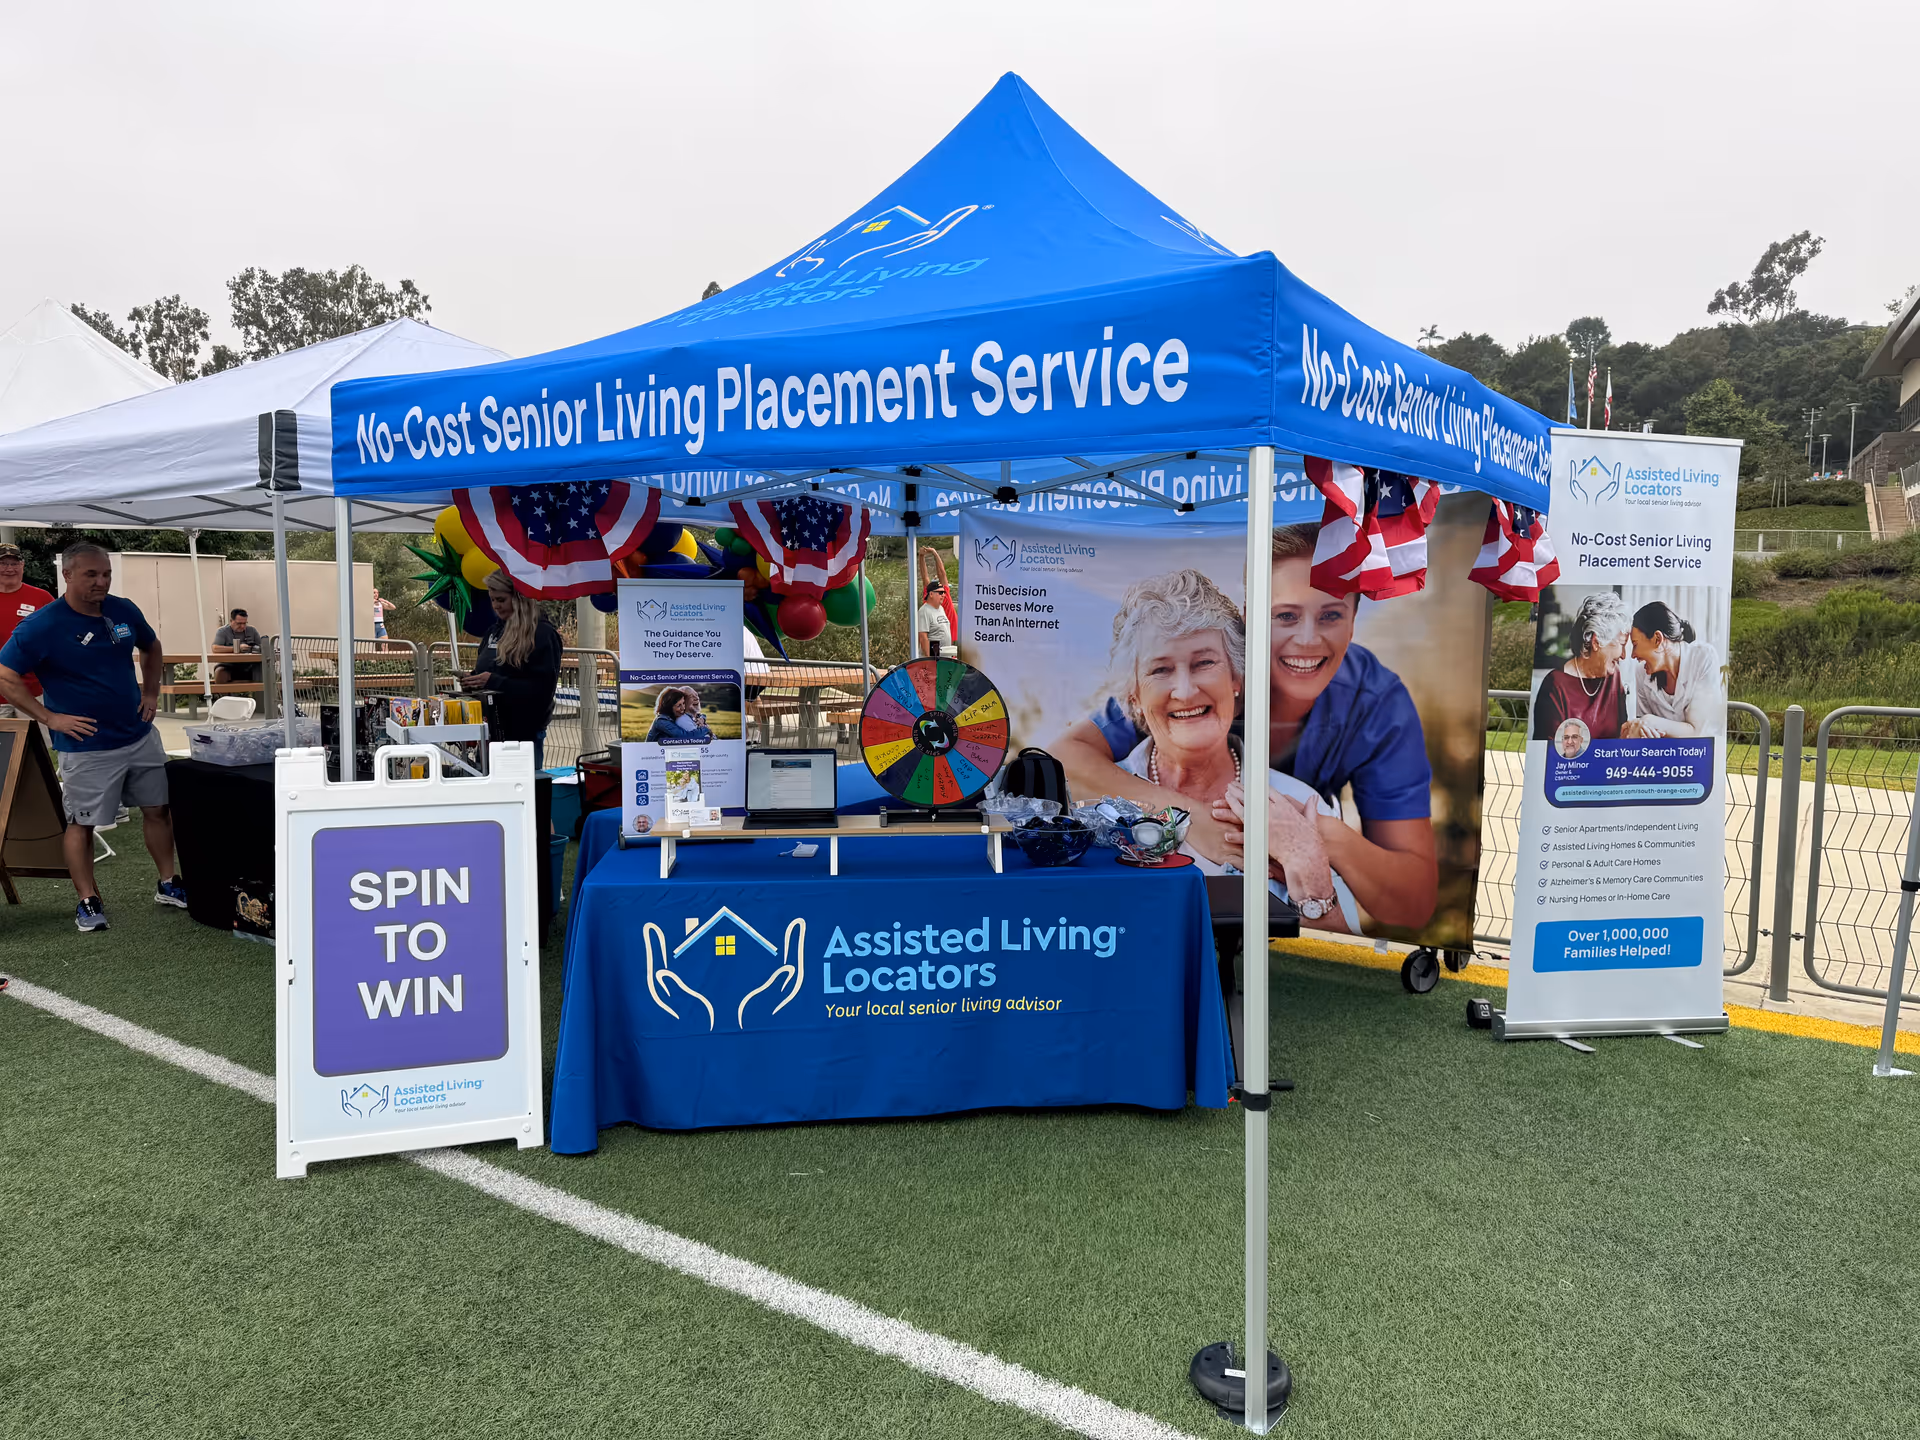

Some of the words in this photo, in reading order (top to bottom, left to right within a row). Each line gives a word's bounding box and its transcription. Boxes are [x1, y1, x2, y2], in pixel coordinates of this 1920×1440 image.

[829, 257, 989, 287] Living
[356, 401, 475, 464] No-Cost
[480, 388, 587, 453] Senior
[595, 373, 705, 455] Living
[717, 348, 957, 432] Placement
[971, 326, 1189, 417] Service
[1301, 323, 1391, 427] No-Cost
[1388, 363, 1440, 441] Senior
[1441, 384, 1481, 474] Living
[1482, 403, 1538, 481] Placement
[1625, 466, 1681, 482] Assisted
[1683, 468, 1719, 487] Living
[1624, 481, 1682, 497] Locators
[1571, 532, 1626, 546] No-Cost
[1629, 533, 1673, 547] Senior
[1676, 534, 1712, 552] Living
[1021, 543, 1062, 555] Assisted
[1064, 544, 1095, 557] Living
[1020, 553, 1065, 565] Locators
[1579, 554, 1650, 568] Placement
[1654, 555, 1702, 568] Service
[975, 584, 996, 595] This
[998, 585, 1047, 597] Decision
[975, 600, 1021, 612] Deserves
[1024, 602, 1054, 613] More
[974, 615, 1000, 627] Than
[1002, 616, 1014, 627] An
[1016, 617, 1059, 629] Internet
[644, 629, 661, 637] The
[662, 629, 703, 637] Guidance
[705, 629, 721, 638] You
[974, 631, 1015, 642] Search.
[644, 640, 667, 648] Need
[684, 640, 700, 648] The
[701, 640, 722, 648] Care
[653, 650, 674, 659] They
[676, 650, 713, 658] Deserve.
[1594, 748, 1619, 758] Start
[1620, 748, 1640, 758] Your
[1641, 747, 1677, 757] Search
[1678, 747, 1707, 758] Today!
[1555, 761, 1567, 770] Jay
[1568, 761, 1589, 769] Minor
[1605, 766, 1694, 779] 949-444-9055
[1553, 825, 1578, 834] Senior
[1579, 823, 1677, 834] Apartments/Independent
[1677, 822, 1699, 832] Living
[1552, 843, 1586, 851] Assisted
[1586, 842, 1610, 852] Living
[1610, 841, 1636, 850] Homes
[1644, 839, 1696, 849] Communities
[1551, 860, 1585, 869] Personal
[1586, 860, 1592, 868] &
[1593, 859, 1613, 868] Adult
[1614, 858, 1632, 867] Care
[1633, 858, 1661, 866] Homes
[1596, 877, 1601, 885] &
[1602, 876, 1632, 886] Memory
[1633, 875, 1652, 884] Care
[1653, 873, 1704, 883] Communities
[349, 866, 470, 911] SPIN
[1549, 895, 1578, 905] Nursing
[1580, 894, 1607, 903] Homes
[1617, 893, 1650, 901] In-Home
[1651, 892, 1671, 901] Care
[374, 921, 447, 963] TO
[823, 917, 990, 958] Assisted
[1568, 930, 1599, 942] Over
[1602, 927, 1669, 943] 1,000,000
[1564, 945, 1618, 959] Families
[1619, 944, 1671, 959] Helped!
[823, 959, 996, 994] Locators
[357, 974, 463, 1020] WIN
[825, 1001, 861, 1018] Your
[866, 999, 904, 1017] local
[908, 999, 957, 1016] senior
[961, 996, 1002, 1016] living
[1006, 996, 1062, 1012] advisor
[394, 1080, 444, 1097] Assisted
[446, 1078, 482, 1091] Living
[394, 1092, 447, 1107] Locators
